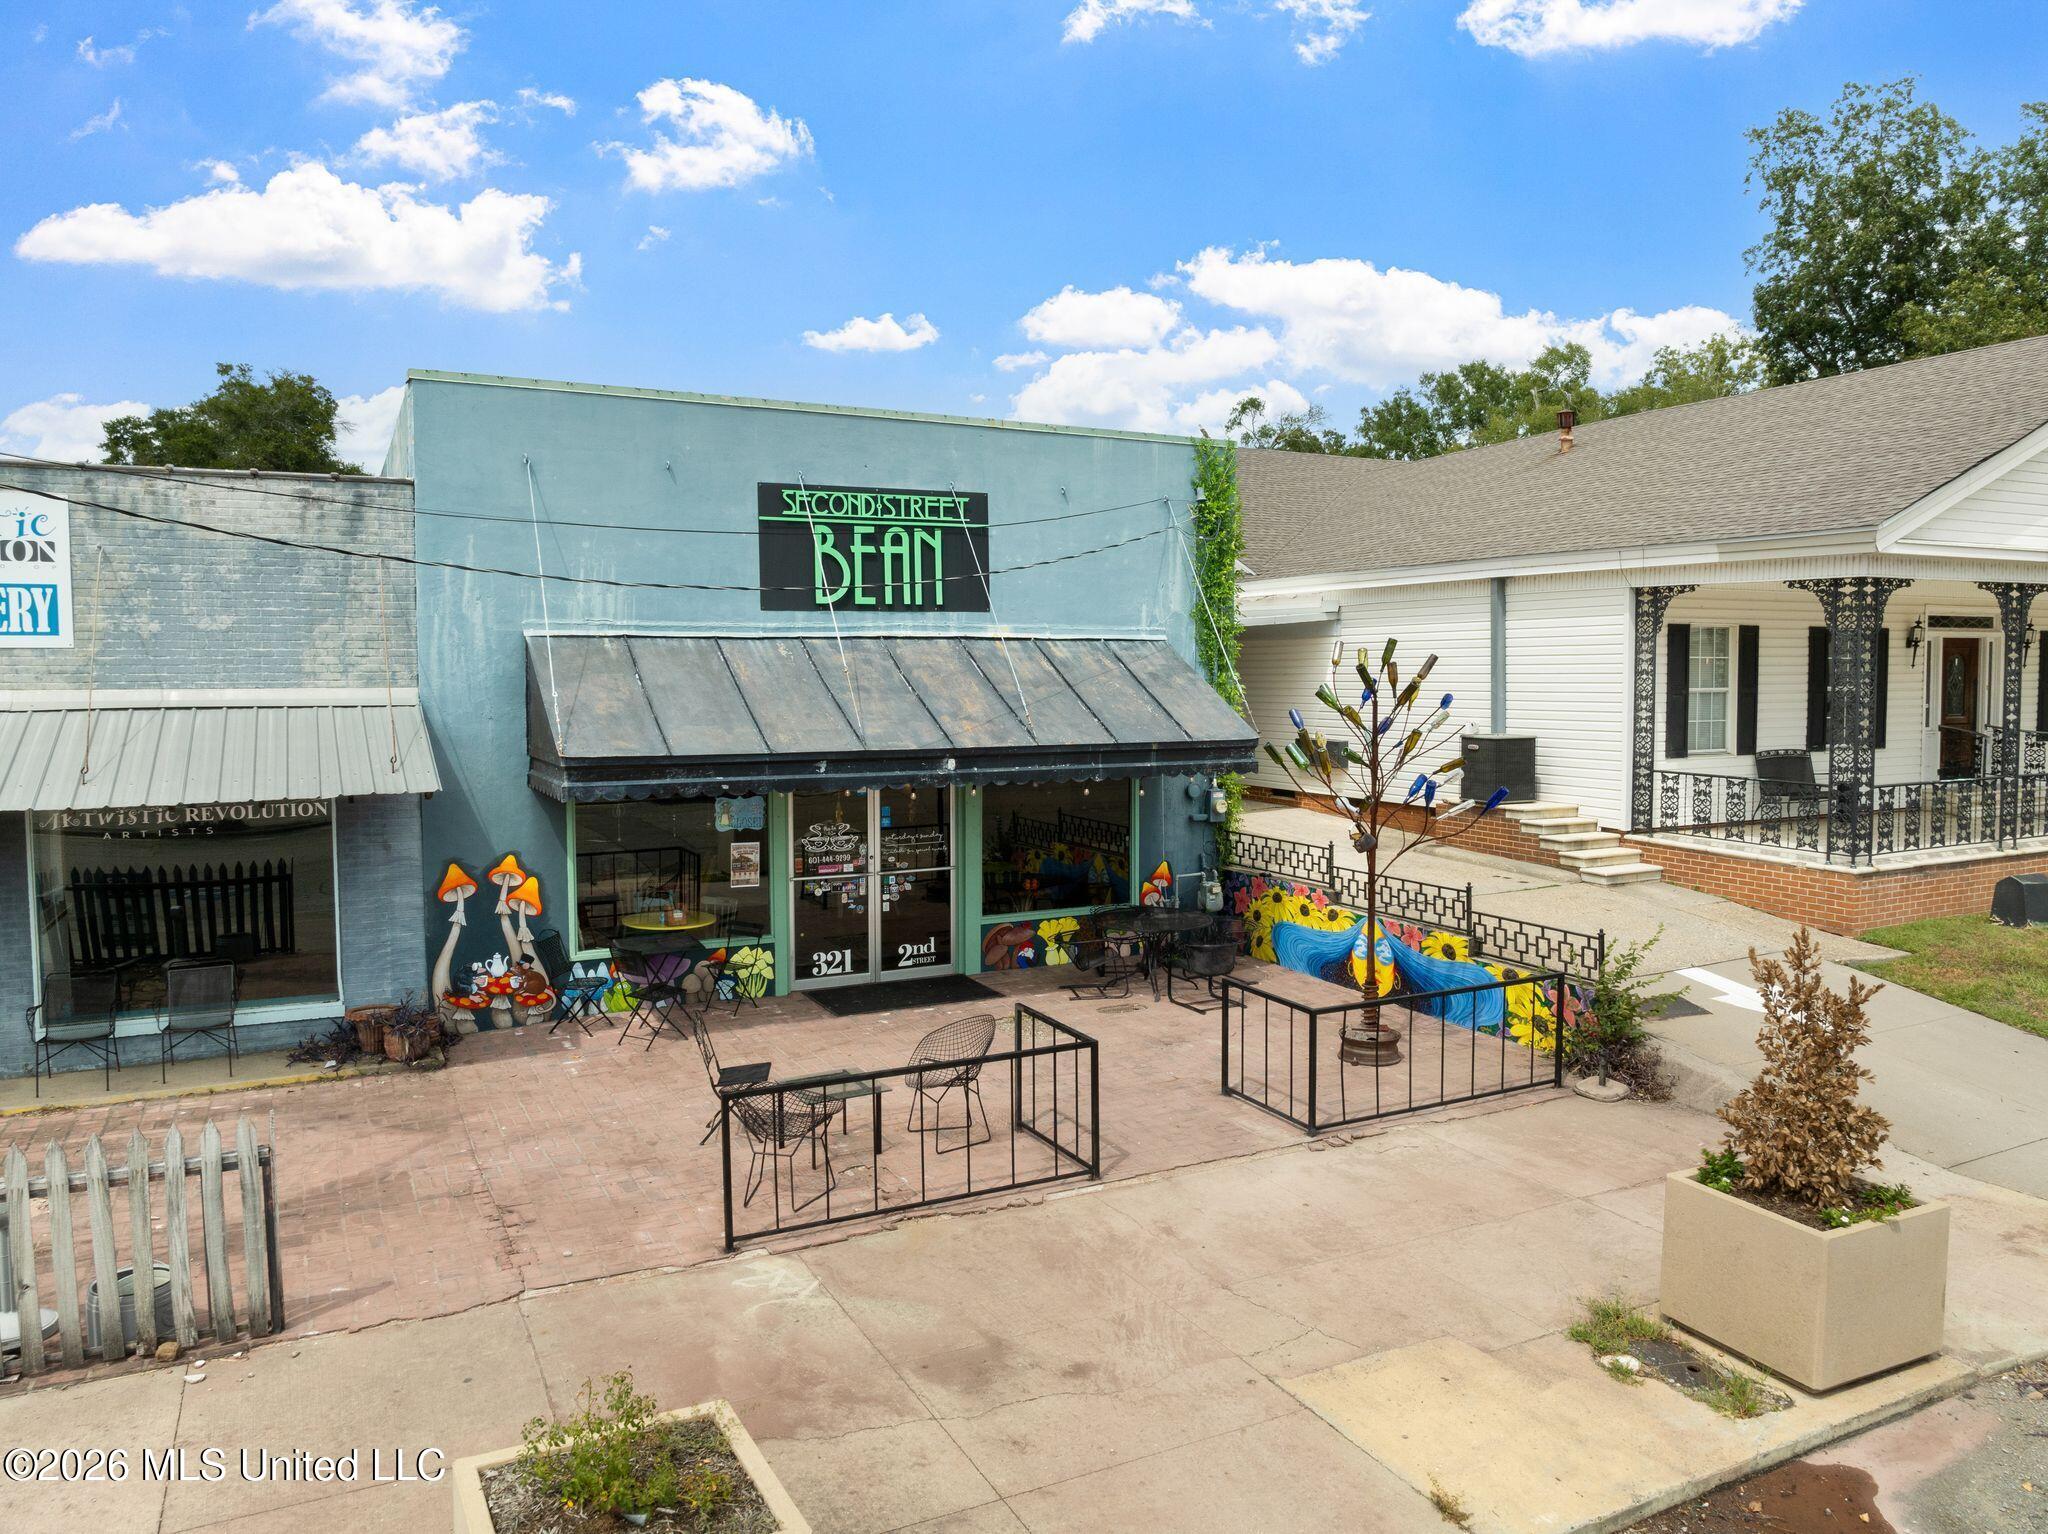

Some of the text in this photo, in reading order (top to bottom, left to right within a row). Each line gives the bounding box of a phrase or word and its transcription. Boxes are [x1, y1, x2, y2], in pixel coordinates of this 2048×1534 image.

[782, 489, 971, 522] SECOND STREET
[814, 525, 944, 606] BEAN
[185, 801, 329, 823] REVOLUTION
[103, 826, 214, 840] ARTISTS
[812, 936, 936, 977] 321 2nd
[912, 955, 937, 964] STREET
